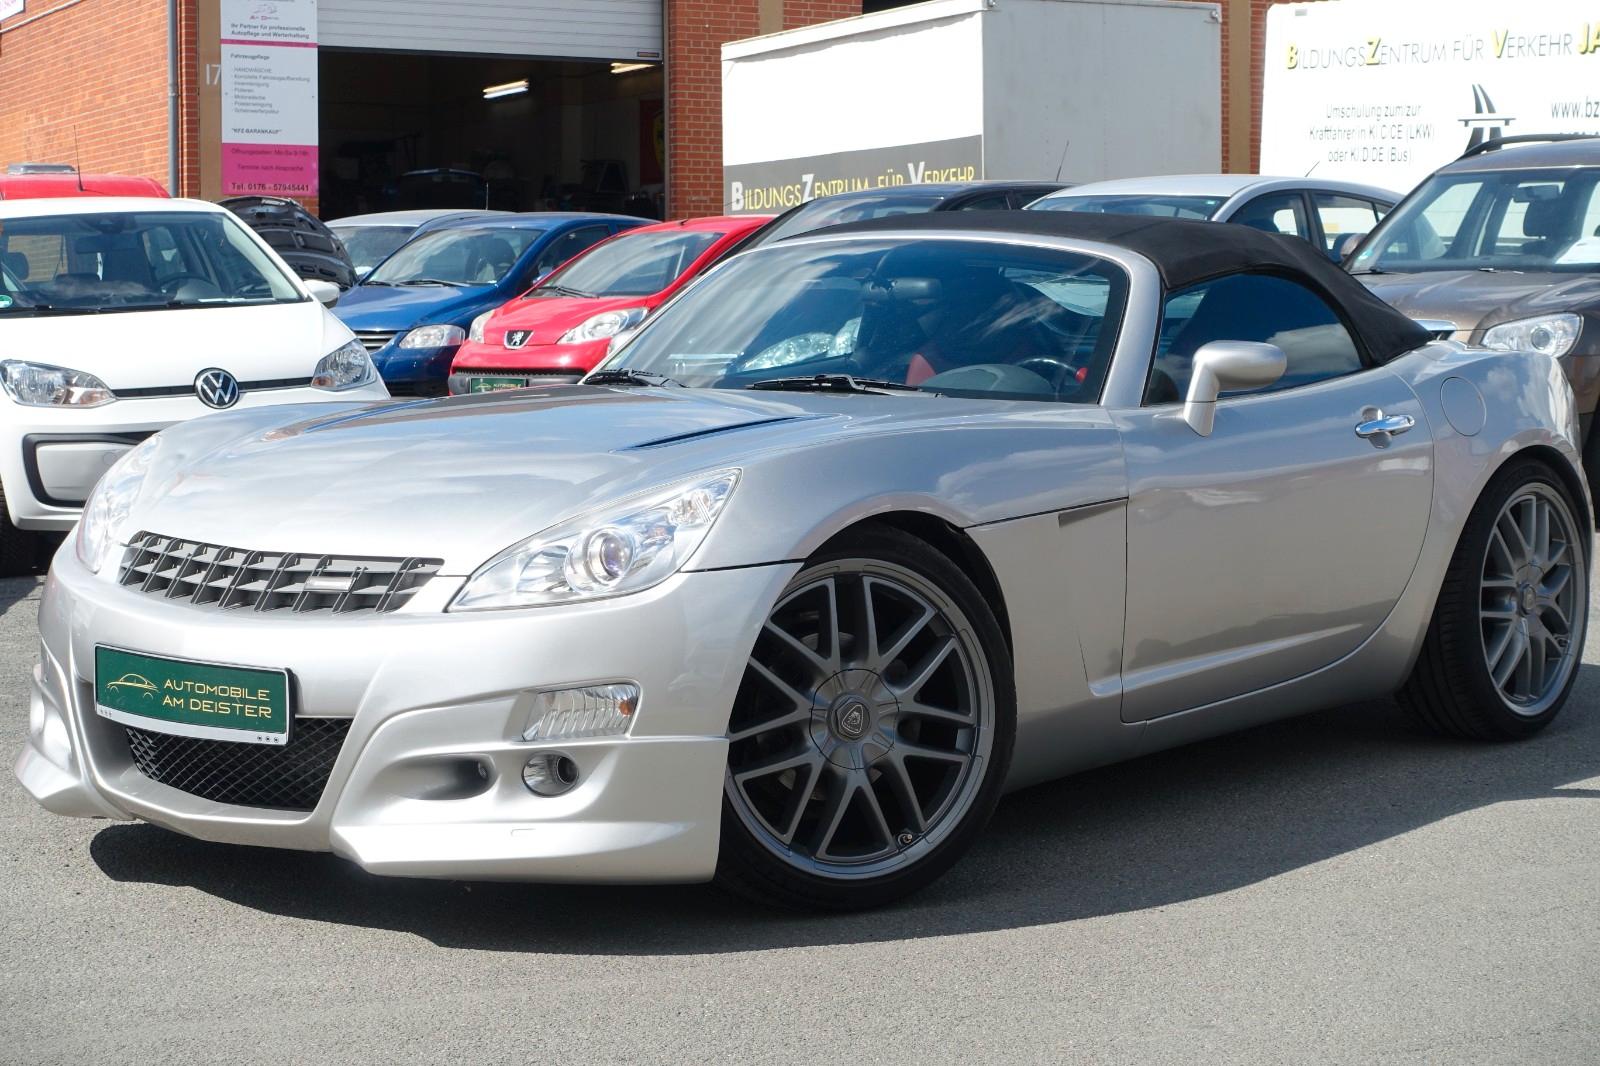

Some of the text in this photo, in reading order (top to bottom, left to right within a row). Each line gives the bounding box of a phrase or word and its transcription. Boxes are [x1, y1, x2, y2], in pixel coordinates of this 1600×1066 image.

[1286, 36, 1448, 70] BILDUNGSZENTRUM
[1453, 33, 1484, 61] FÜR
[1491, 27, 1573, 59] VERKEHR
[205, 63, 222, 86] 17
[1326, 104, 1382, 121] Umschulung
[1328, 150, 1348, 162] oder
[231, 182, 246, 191] Tel.
[247, 182, 267, 191] 0176
[163, 678, 271, 701] AUTOMOBILE
[162, 694, 272, 719] AM DEISTER
